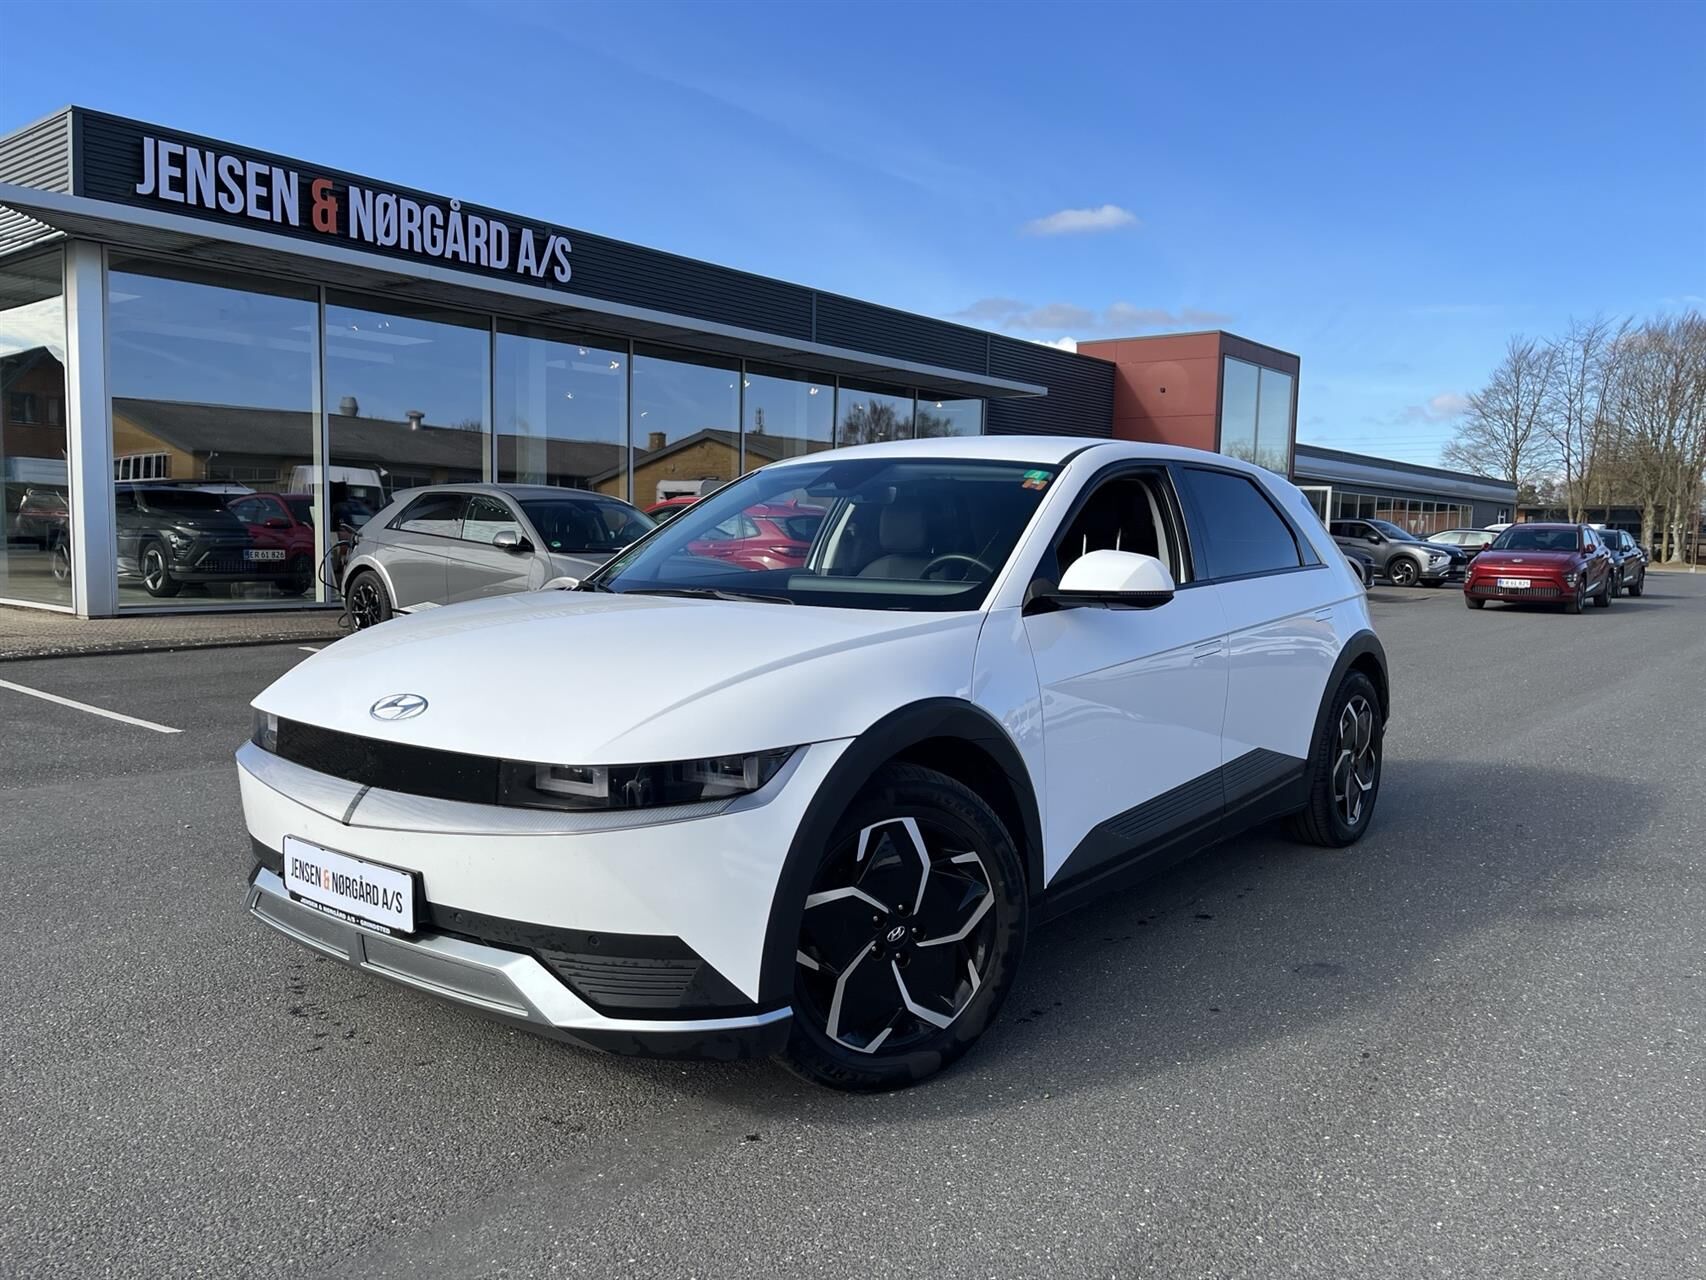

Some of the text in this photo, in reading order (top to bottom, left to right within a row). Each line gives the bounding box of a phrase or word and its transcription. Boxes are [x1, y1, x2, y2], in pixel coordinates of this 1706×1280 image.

[136, 136, 573, 283] JENSEN & NØRGÅRD A/S
[290, 857, 404, 914] JENSEN & NØRGÅRD A/S
